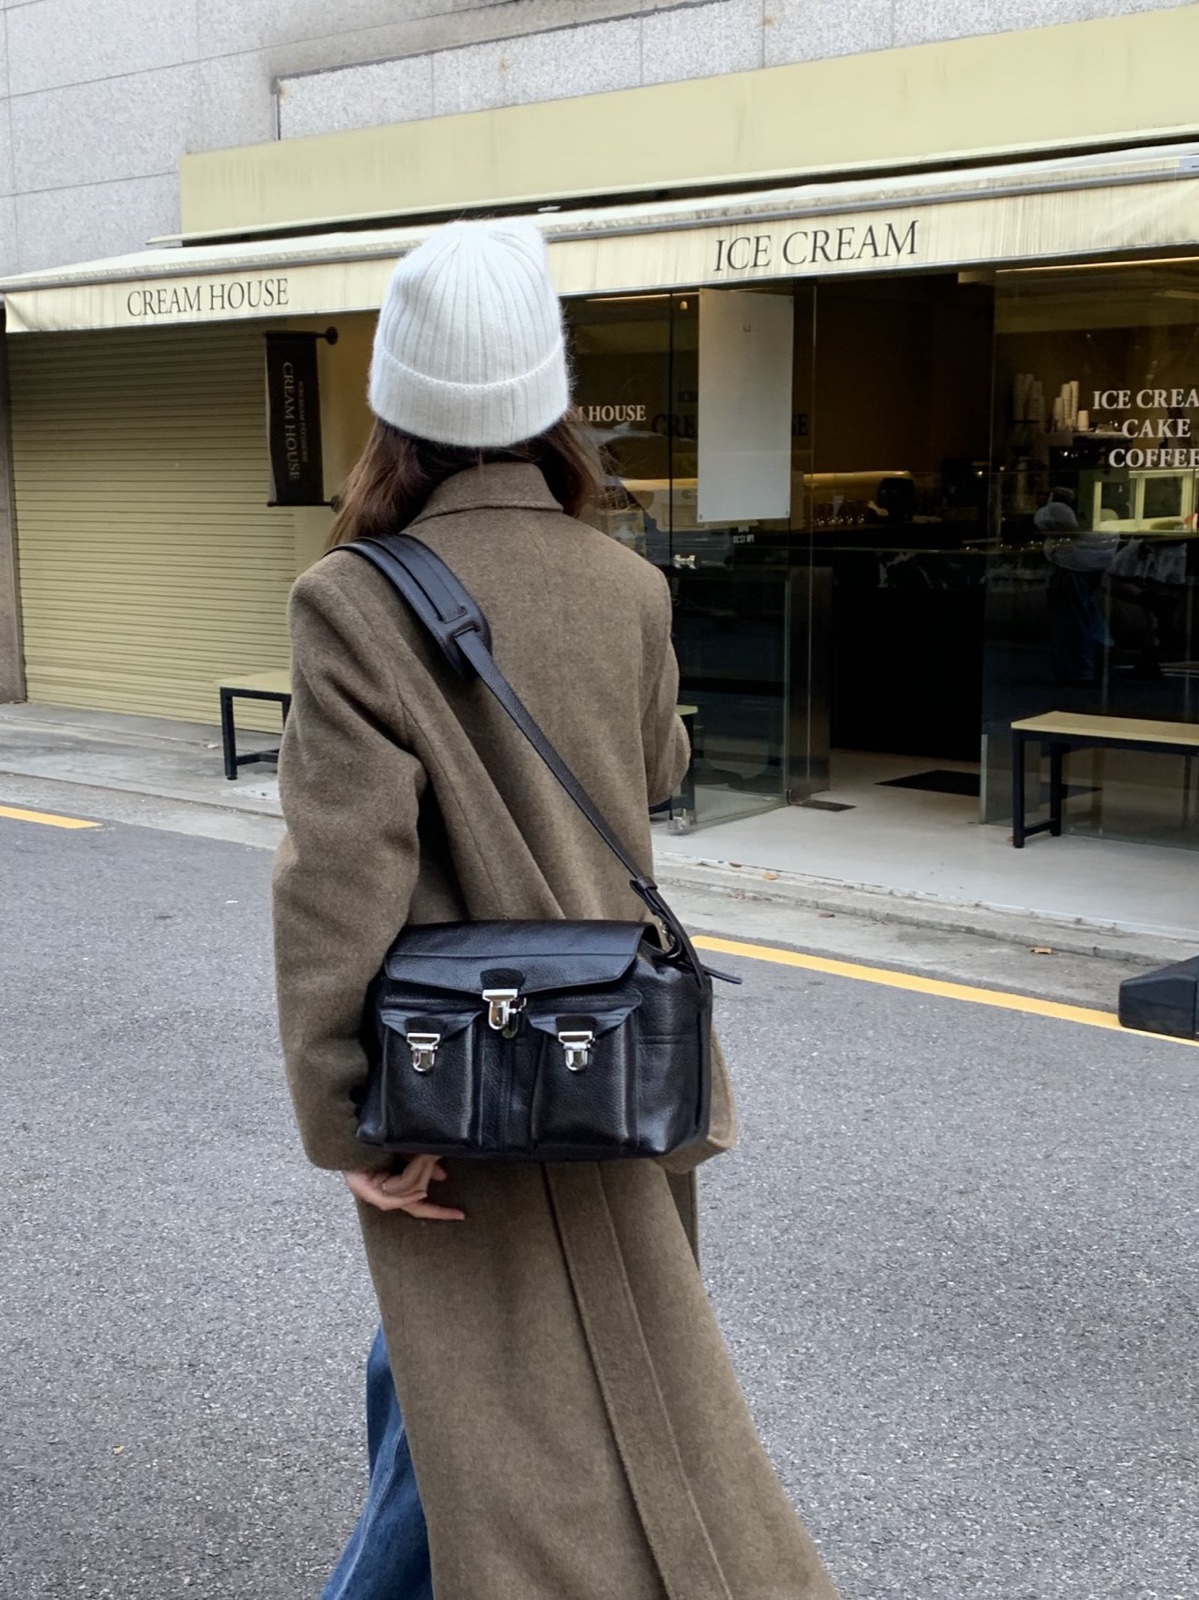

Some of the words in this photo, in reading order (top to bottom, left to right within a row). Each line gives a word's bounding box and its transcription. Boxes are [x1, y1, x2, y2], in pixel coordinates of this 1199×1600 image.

[713, 233, 772, 272] ICE
[782, 219, 919, 265] CREAM
[127, 286, 201, 316] CREAM
[209, 278, 289, 311] HOUSE
[282, 361, 296, 419] CREAM
[1092, 390, 1131, 409] ICE
[1136, 388, 1199, 408] CREA
[588, 404, 647, 422] HOUSE
[1122, 418, 1191, 438] CAKE
[284, 424, 300, 481] HOUSE
[1108, 448, 1199, 468] COFFEE
